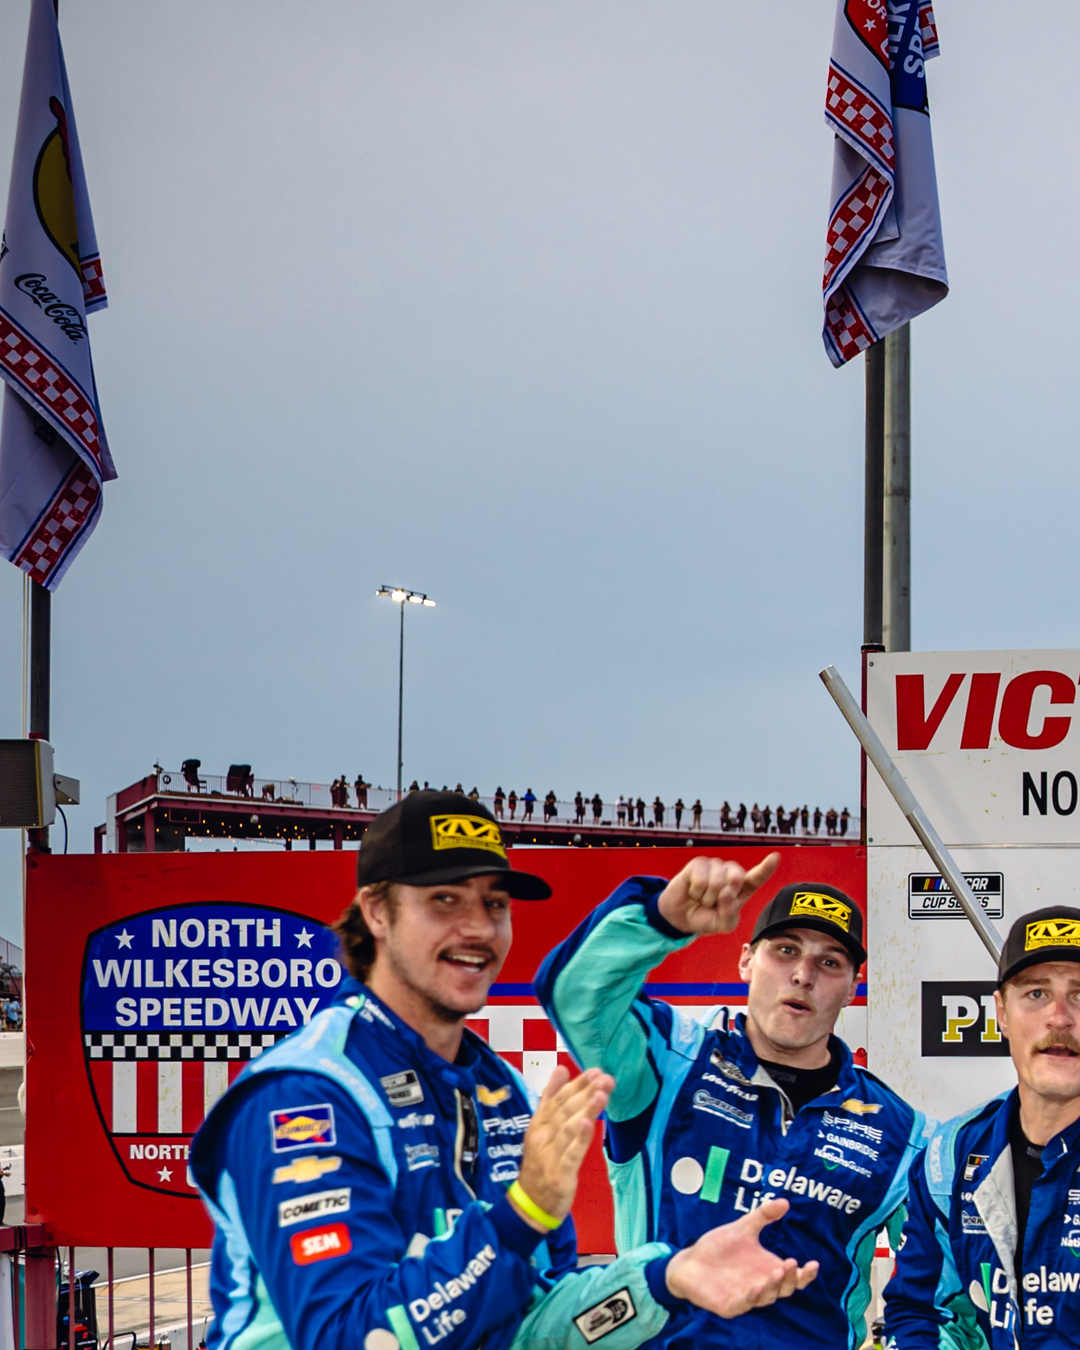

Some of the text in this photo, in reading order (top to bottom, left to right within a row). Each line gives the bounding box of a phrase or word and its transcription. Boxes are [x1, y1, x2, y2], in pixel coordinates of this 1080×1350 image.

[922, 897, 947, 908] CUP
[151, 918, 281, 947] NORTH
[93, 958, 342, 988] WILKESBORO
[115, 997, 320, 1027] SPEEDWAY
[734, 1186, 776, 1214] Lif
[740, 1158, 861, 1214] Delaware
[283, 1195, 347, 1220] COMETIC
[302, 1232, 341, 1256] SEM
[422, 1309, 467, 1345] Life
